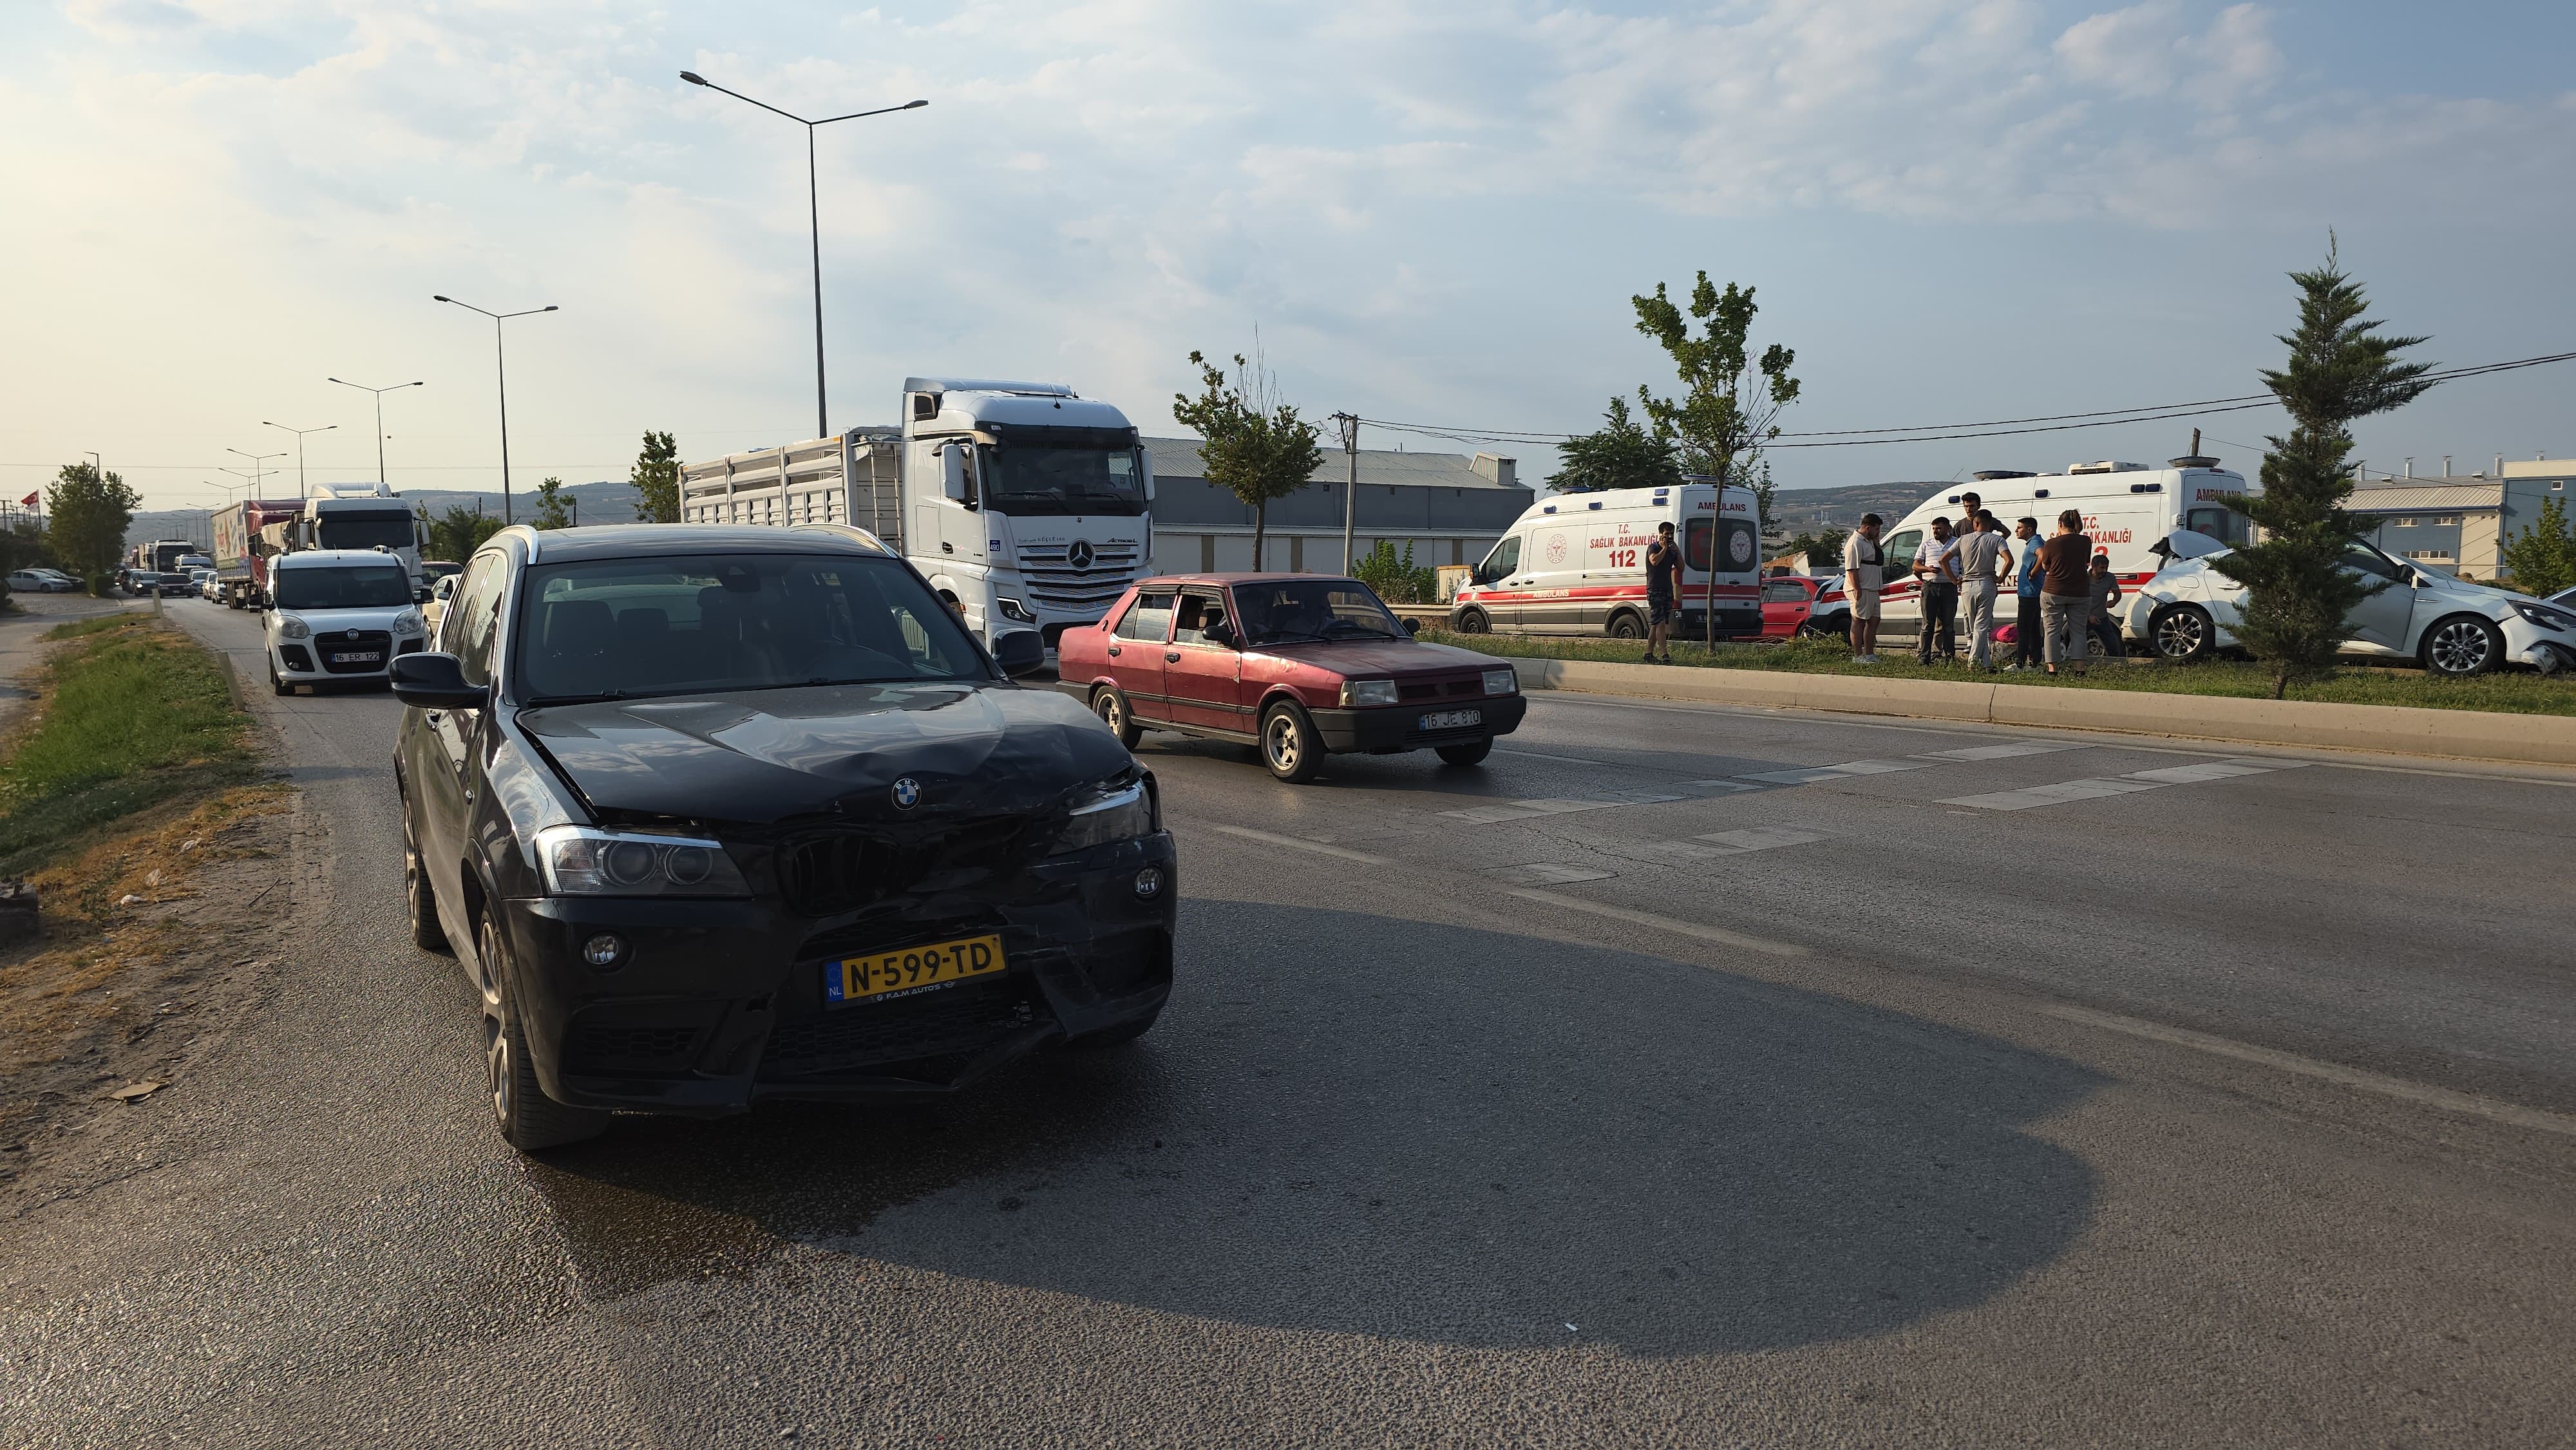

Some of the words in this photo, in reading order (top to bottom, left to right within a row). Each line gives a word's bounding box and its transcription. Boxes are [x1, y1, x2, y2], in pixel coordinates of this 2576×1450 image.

[1618, 524, 1630, 534] T.C.
[2083, 516, 2099, 529] T.C.
[2083, 528, 2132, 543] AKANLIĞI
[1590, 536, 1615, 549] SAĞLIK
[1609, 550, 1636, 567] 112
[1533, 589, 1569, 598] AMBULANS
[1426, 715, 1437, 727] 16
[1443, 713, 1458, 726] JE
[896, 780, 920, 790] BMW
[851, 943, 991, 993] N-599-TD
[829, 986, 842, 997] NL
